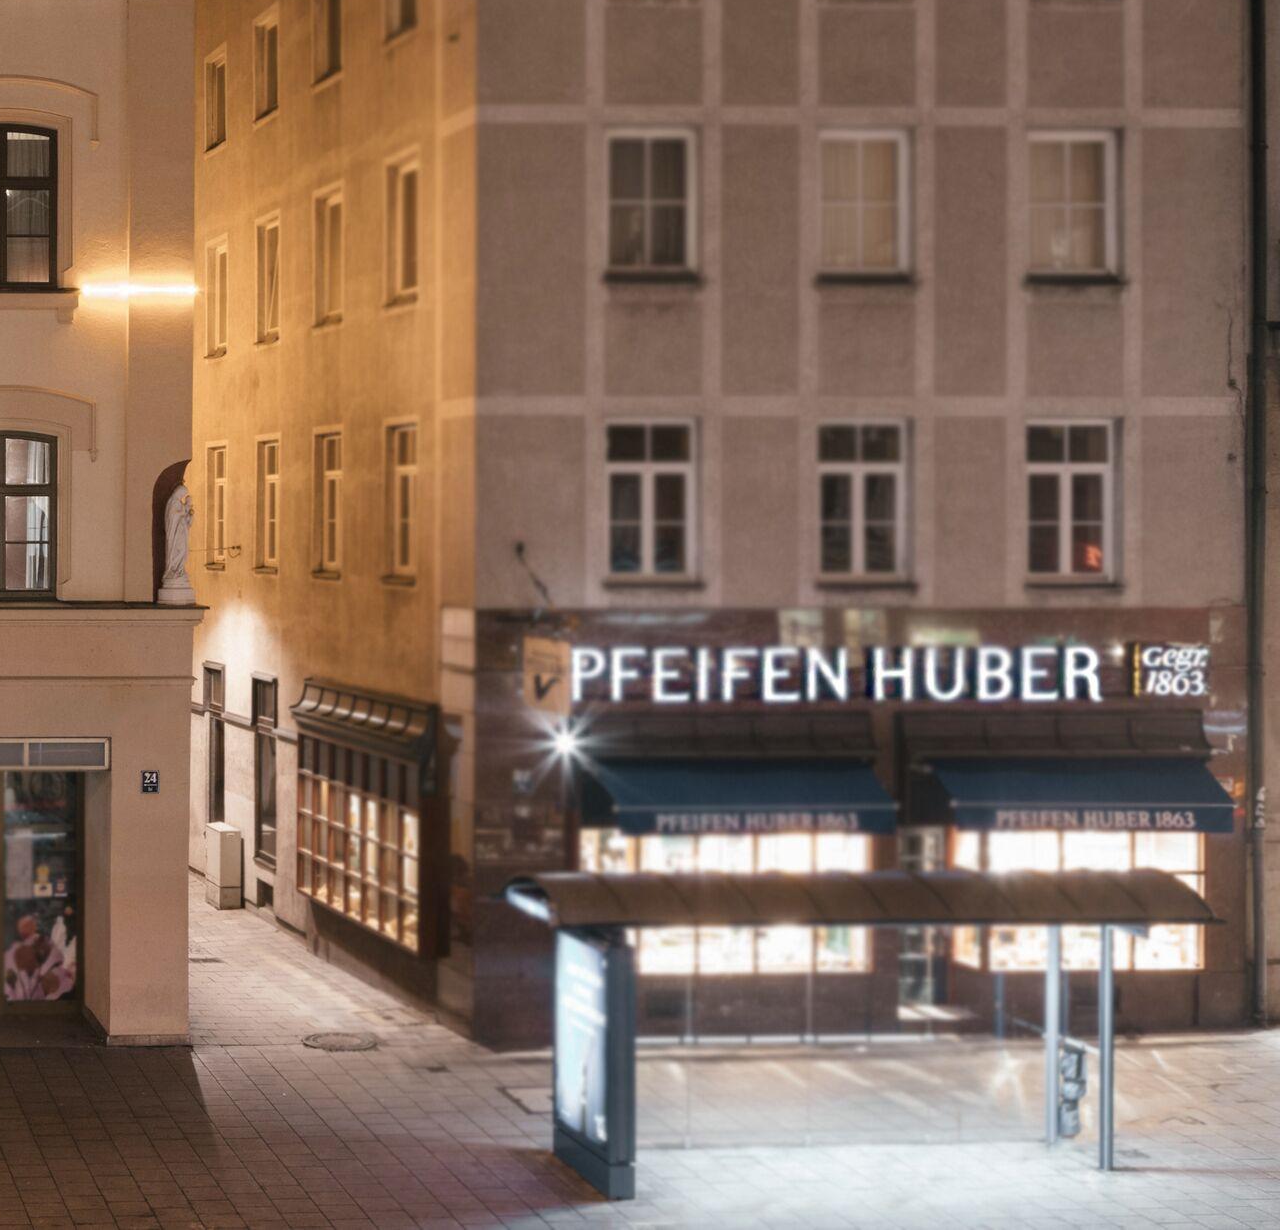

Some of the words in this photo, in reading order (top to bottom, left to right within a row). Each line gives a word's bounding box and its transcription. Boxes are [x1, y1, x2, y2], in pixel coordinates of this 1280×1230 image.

[1142, 646, 1208, 672] Gegr.
[570, 647, 848, 702] PFEIFEN
[872, 646, 1103, 702] HUBER
[1146, 670, 1205, 696] 1863
[144, 772, 157, 783] 24
[656, 813, 740, 831] PFEIFEN
[744, 813, 814, 830] HUBER
[996, 810, 1078, 828] PFEIFEN
[1082, 810, 1152, 828] HUBER
[1155, 811, 1196, 828] 1863
